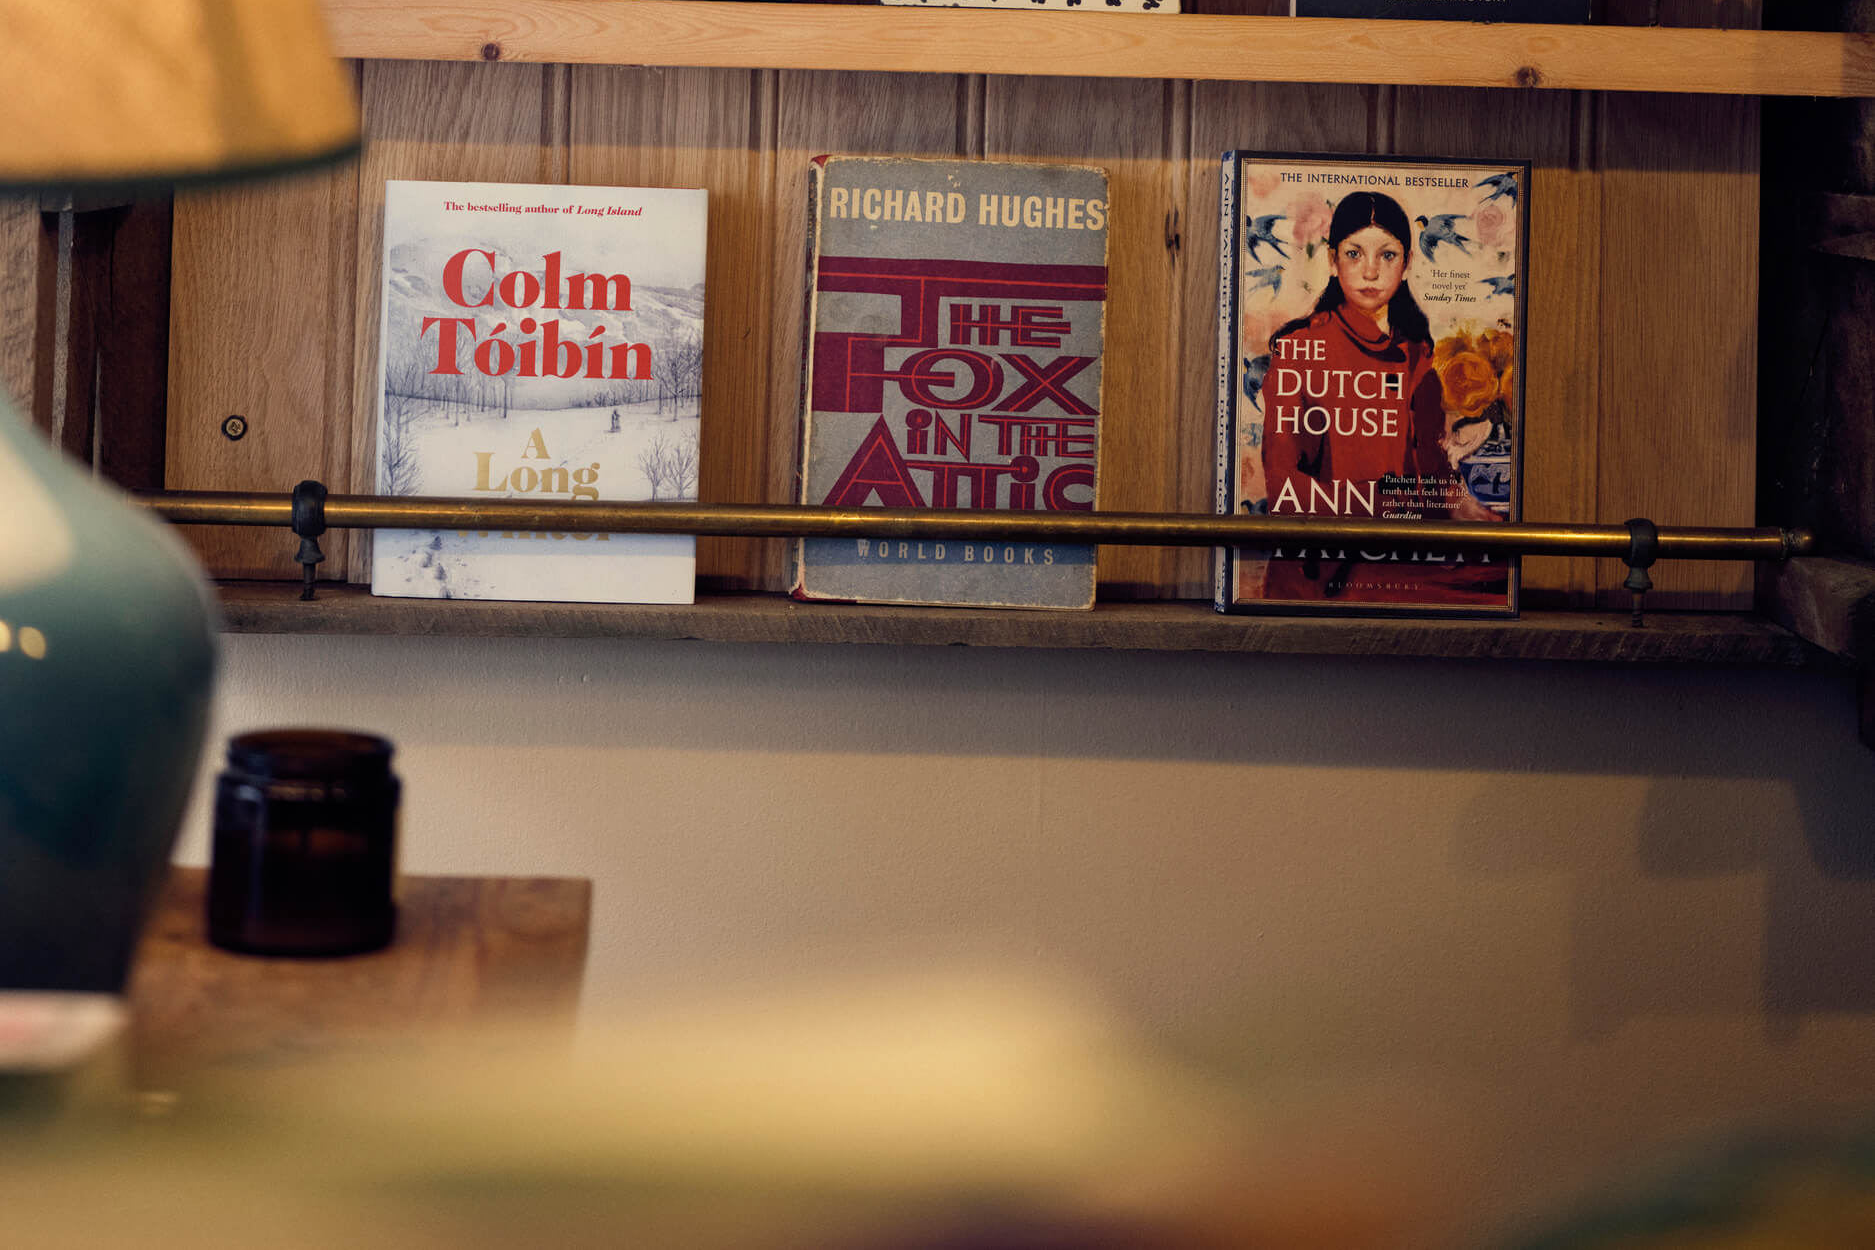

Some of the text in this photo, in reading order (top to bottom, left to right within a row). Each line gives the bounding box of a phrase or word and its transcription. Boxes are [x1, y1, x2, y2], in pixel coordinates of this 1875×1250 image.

[1280, 172, 1469, 189] THE INTERNATIONAL BESTSELLER
[444, 201, 643, 218] The bestselling author of Long Island
[830, 188, 1106, 232] RICHARD HUGHES
[442, 249, 634, 312] Colm
[1432, 281, 1451, 291] novel
[1449, 270, 1471, 280] finest
[1423, 292, 1477, 304] Sunday Times
[421, 316, 655, 381] Tóibín
[1275, 338, 1326, 361] THE
[811, 332, 1099, 416] FOX
[1276, 368, 1405, 401] DUTCH
[1275, 406, 1399, 437] HOUSE
[521, 427, 551, 459] A
[978, 415, 1096, 459] THE
[474, 451, 601, 500] Long
[1418, 475, 1437, 486] leads
[1438, 477, 1447, 486] us
[1449, 477, 1457, 486] to
[1272, 477, 1378, 517] ANN
[1382, 487, 1399, 496] truth
[1400, 487, 1419, 496] that
[1421, 487, 1438, 497] feels
[1439, 488, 1455, 497] like
[1382, 499, 1405, 509] rather
[1406, 500, 1425, 509] than
[1382, 510, 1422, 521] Guardian
[857, 539, 1055, 565] WORLD BOOKS
